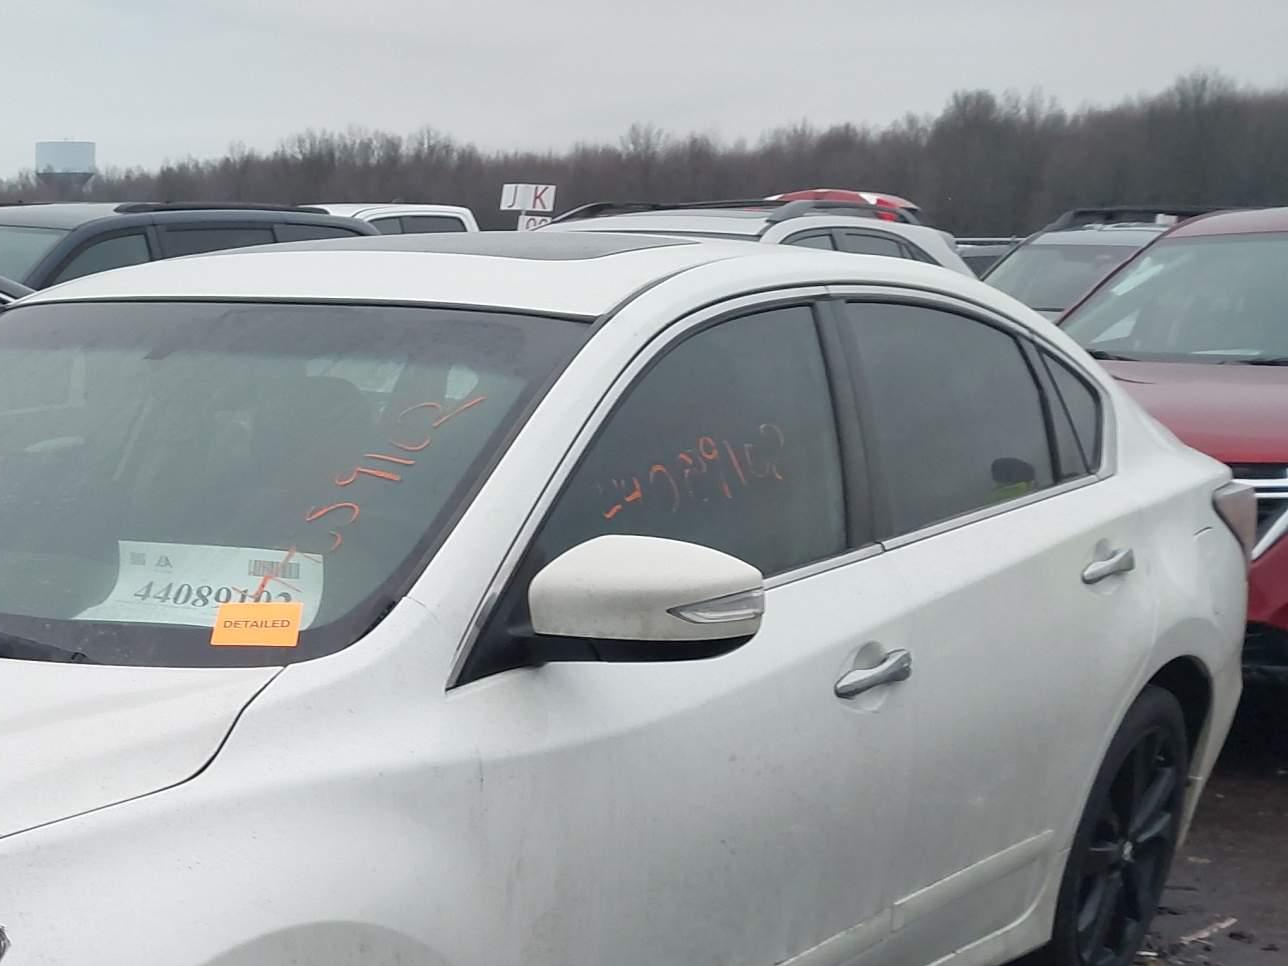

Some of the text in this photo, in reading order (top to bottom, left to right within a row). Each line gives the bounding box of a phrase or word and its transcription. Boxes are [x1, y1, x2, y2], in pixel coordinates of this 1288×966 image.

[507, 185, 550, 209] J K
[223, 619, 291, 629] DETAILED
